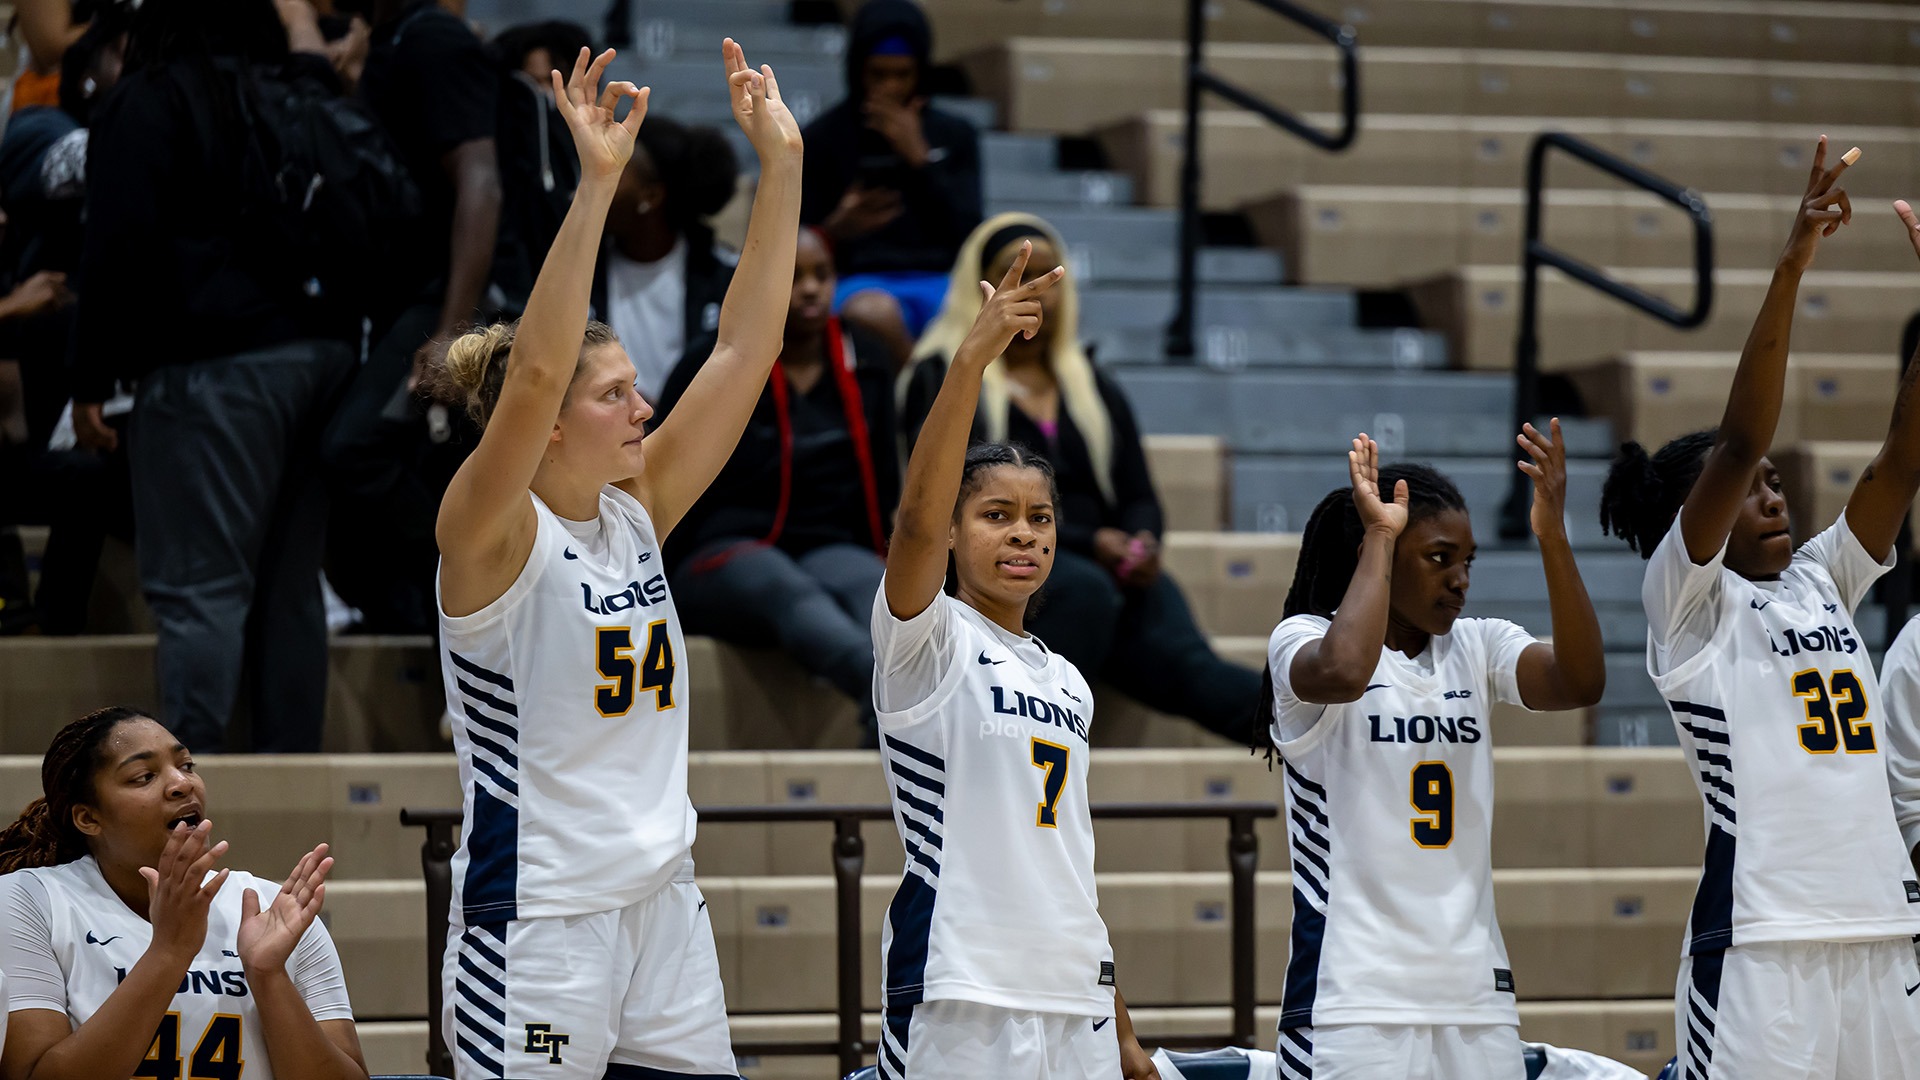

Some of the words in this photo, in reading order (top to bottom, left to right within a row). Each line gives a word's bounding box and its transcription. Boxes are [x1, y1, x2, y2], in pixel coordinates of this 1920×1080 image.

[595, 619, 676, 718] 54
[1766, 625, 1858, 656] LIONS
[991, 686, 1088, 744] LIONS
[1368, 715, 1481, 744] LIONS
[1791, 667, 1878, 754] 32
[1030, 736, 1071, 829] 7
[1410, 760, 1454, 849] 9
[130, 1010, 245, 1080] 44
[524, 1022, 570, 1065] ET
